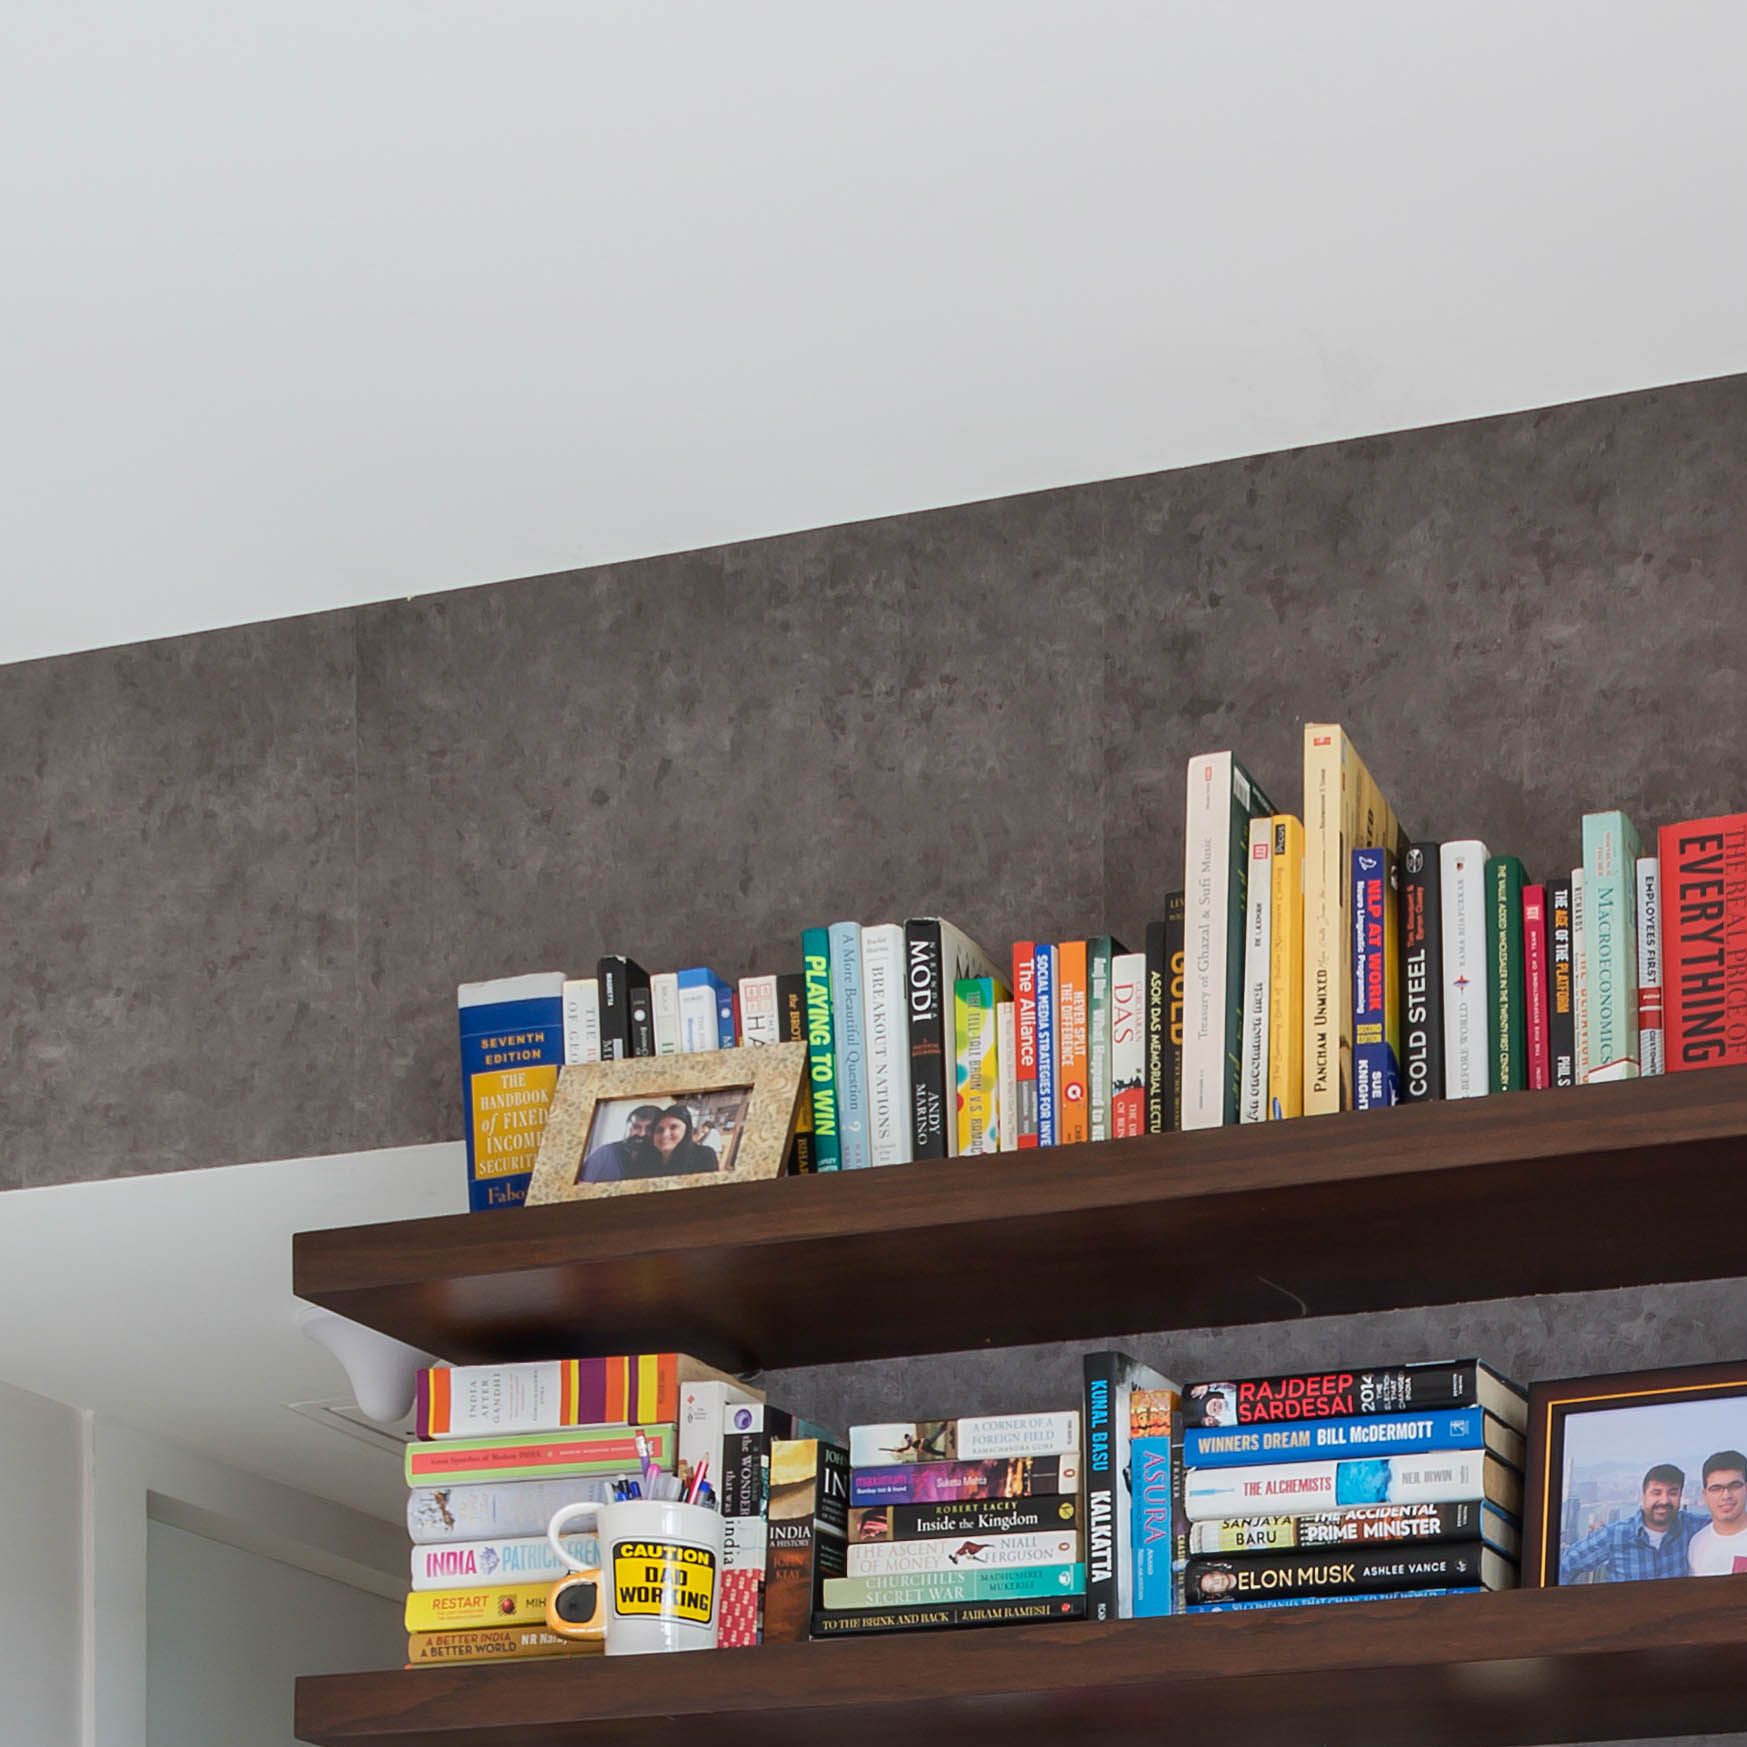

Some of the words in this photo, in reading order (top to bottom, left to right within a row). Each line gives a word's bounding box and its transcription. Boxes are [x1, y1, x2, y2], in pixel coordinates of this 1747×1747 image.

[1725, 826, 1747, 872] THE
[1367, 879, 1382, 915] NLP
[1726, 880, 1747, 943] REAL
[1369, 919, 1381, 947] AT
[1679, 833, 1726, 1063] EVERYTHING
[910, 941, 931, 1022] MODI
[1019, 959, 1034, 992] The
[1037, 954, 1048, 993] SOCIAL
[1369, 952, 1382, 1011] WORK
[1407, 950, 1426, 1023] STEEL
[1726, 951, 1747, 1018] PRICE
[805, 956, 832, 1046] PLAYING
[481, 1032, 545, 1049] SEVENTH
[1020, 999, 1036, 1066] Alliance
[485, 1049, 541, 1065] EDITION
[811, 1053, 832, 1081] TO
[1409, 1027, 1427, 1096] COLD
[501, 1072, 526, 1088] THE
[480, 1089, 548, 1110] HANDBOOK
[813, 1090, 835, 1136] WIN
[482, 1113, 498, 1139] of
[1090, 1380, 1107, 1429] KUNAL
[1240, 1374, 1354, 1402] RAJDEEP
[1362, 1377, 1375, 1412] 2014
[1239, 1397, 1354, 1423] SARDESAI
[1091, 1433, 1108, 1471] BASU
[1198, 1435, 1259, 1453] WINNERS
[1263, 1430, 1310, 1448] DREAM
[1317, 1428, 1346, 1446] BILL
[1350, 1421, 1434, 1442] McDERMOTT
[1143, 1451, 1167, 1544] ASURA
[917, 1516, 956, 1531] Inside
[959, 1517, 975, 1529] the
[978, 1512, 1038, 1530] Kingdom
[1090, 1490, 1111, 1584] KALKATTA
[1307, 1522, 1359, 1542] PRIME
[1362, 1519, 1440, 1538] MINISTER
[426, 1552, 477, 1578] INDIA
[621, 1543, 710, 1566] CAUTION
[645, 1567, 687, 1587] DAD
[1239, 1570, 1296, 1590] ELON
[1300, 1564, 1355, 1585] MUSK
[1363, 1565, 1404, 1577] ASHLEE
[1409, 1562, 1446, 1573] VANCE
[432, 1596, 490, 1612] RESTART
[620, 1587, 709, 1612] WORKING
